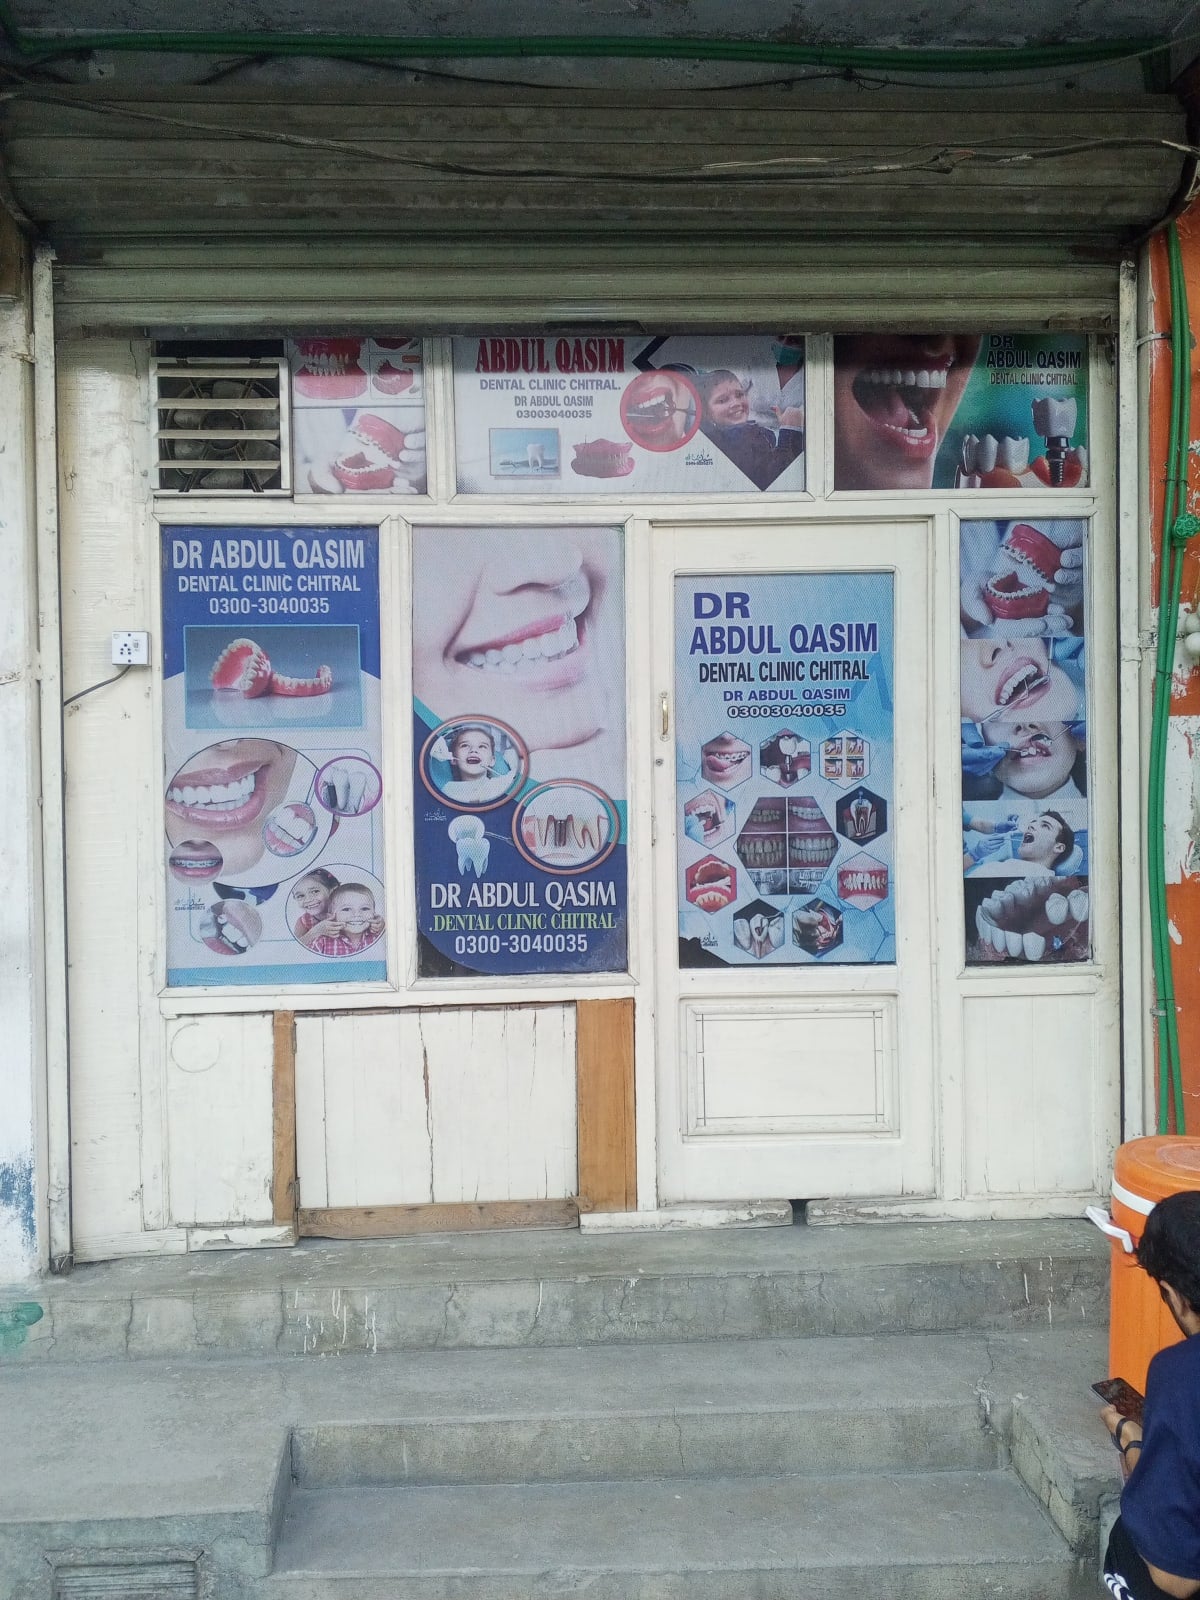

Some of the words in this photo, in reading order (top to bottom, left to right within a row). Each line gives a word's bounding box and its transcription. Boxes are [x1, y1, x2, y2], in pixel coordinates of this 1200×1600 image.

[990, 335, 1014, 347] DR
[475, 338, 550, 373] ABDUL
[555, 338, 624, 373] QASIM
[987, 351, 1032, 368] ABDUL
[1036, 351, 1081, 368] QASIM
[480, 379, 525, 390] DENTAL
[528, 379, 566, 390] CLINIC
[569, 379, 621, 390] CHITRAL.
[990, 373, 1019, 385] DENTAL
[1020, 373, 1044, 385] CLINIC
[514, 396, 527, 407] DR
[530, 396, 560, 407] ABDUL
[563, 395, 593, 407] QASIM
[516, 410, 592, 419] 03003040035
[173, 540, 203, 569] DR
[210, 540, 286, 569] ABDUL
[292, 539, 365, 569] QASIM
[178, 575, 238, 592] DENTAL
[243, 575, 292, 592] CLINIC
[297, 575, 360, 592] CHITRAL
[209, 597, 329, 614] 0300-3040035
[694, 592, 750, 619] DR
[689, 625, 781, 655] ABDUL
[790, 623, 877, 653] QASIM
[699, 662, 754, 683] DENTAL
[758, 661, 805, 681] CLINIC
[810, 660, 869, 680] CHITRAL
[723, 690, 743, 702] DR
[748, 689, 798, 701] ABDUL
[802, 688, 850, 700] QASIM
[727, 703, 846, 718] 03003040035
[431, 883, 461, 909] DR
[466, 882, 539, 908] ABDUL
[545, 881, 616, 911] QASIM
[498, 913, 547, 930] CLINIC
[551, 912, 616, 930] CHITRAL
[455, 934, 588, 954] 0300-3040035
